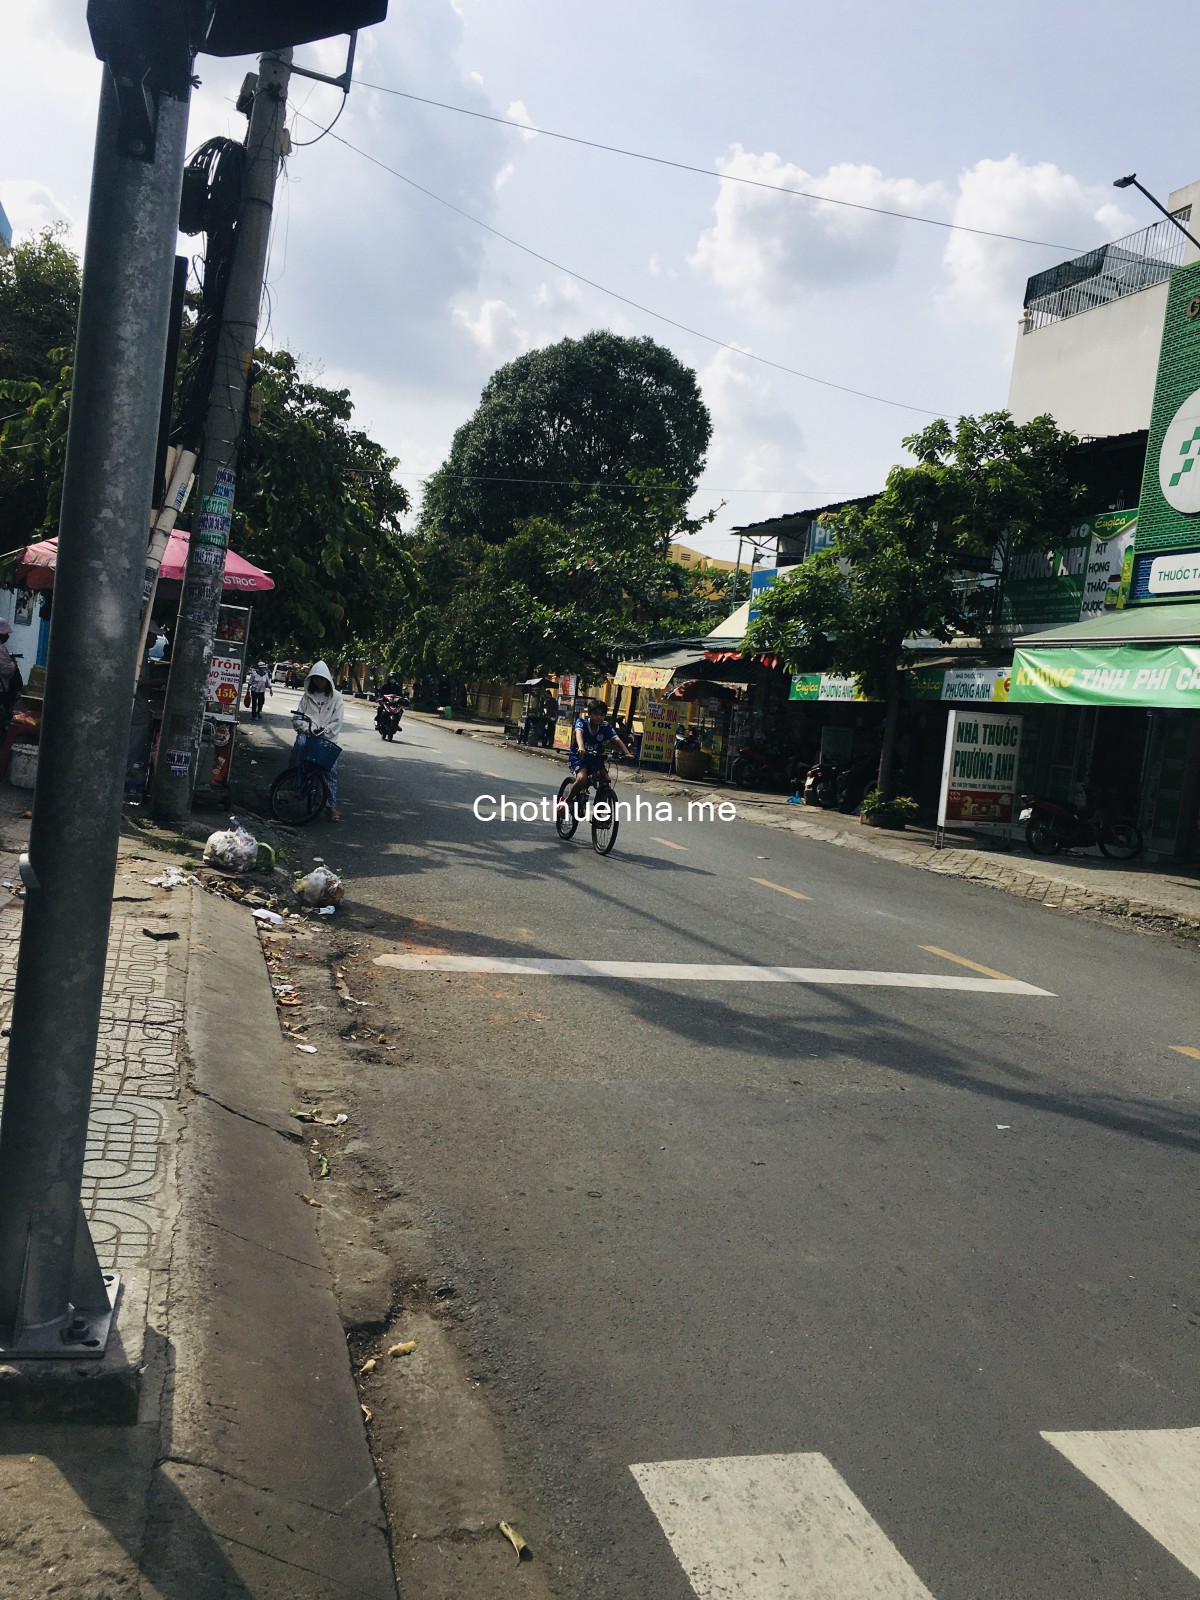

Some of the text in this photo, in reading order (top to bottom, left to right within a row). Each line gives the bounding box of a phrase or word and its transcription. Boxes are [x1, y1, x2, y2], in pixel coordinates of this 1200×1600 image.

[1095, 514, 1126, 531] Eugica
[1057, 546, 1087, 577] ANH
[1158, 566, 1190, 581] THUỐC
[1015, 665, 1076, 687] KHÔNG
[217, 688, 236, 699] 15k
[945, 682, 991, 699] PHƯƠNG ANH
[652, 721, 672, 729] 10K
[956, 718, 1018, 747] NHÀ THUỐC
[953, 747, 1015, 781] PHƯƠNG ANH
